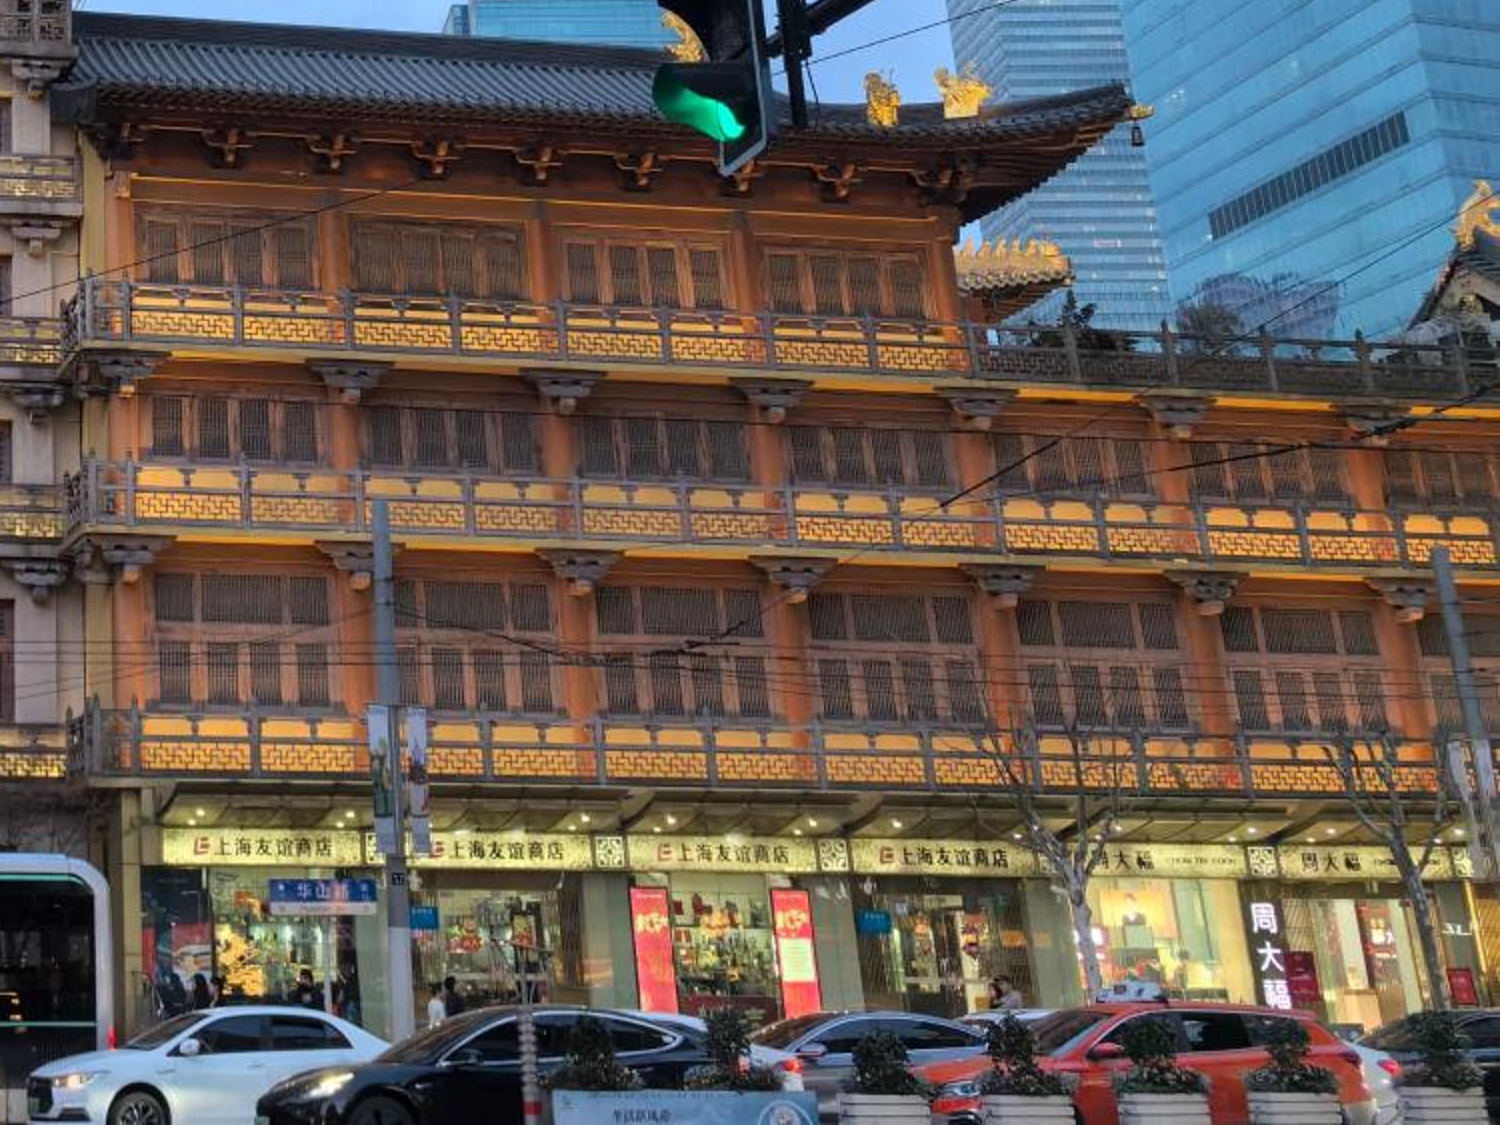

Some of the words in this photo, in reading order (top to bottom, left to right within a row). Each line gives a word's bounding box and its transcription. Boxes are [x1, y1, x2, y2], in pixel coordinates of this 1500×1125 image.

[215, 837, 333, 858] 上海友谊商店
[450, 841, 564, 860] 上海友谊商店
[678, 842, 790, 864] 上海友谊商店
[902, 847, 1009, 868] 上海友谊商店
[1301, 852, 1362, 871] 周大福
[1250, 902, 1293, 1010] 周大福
